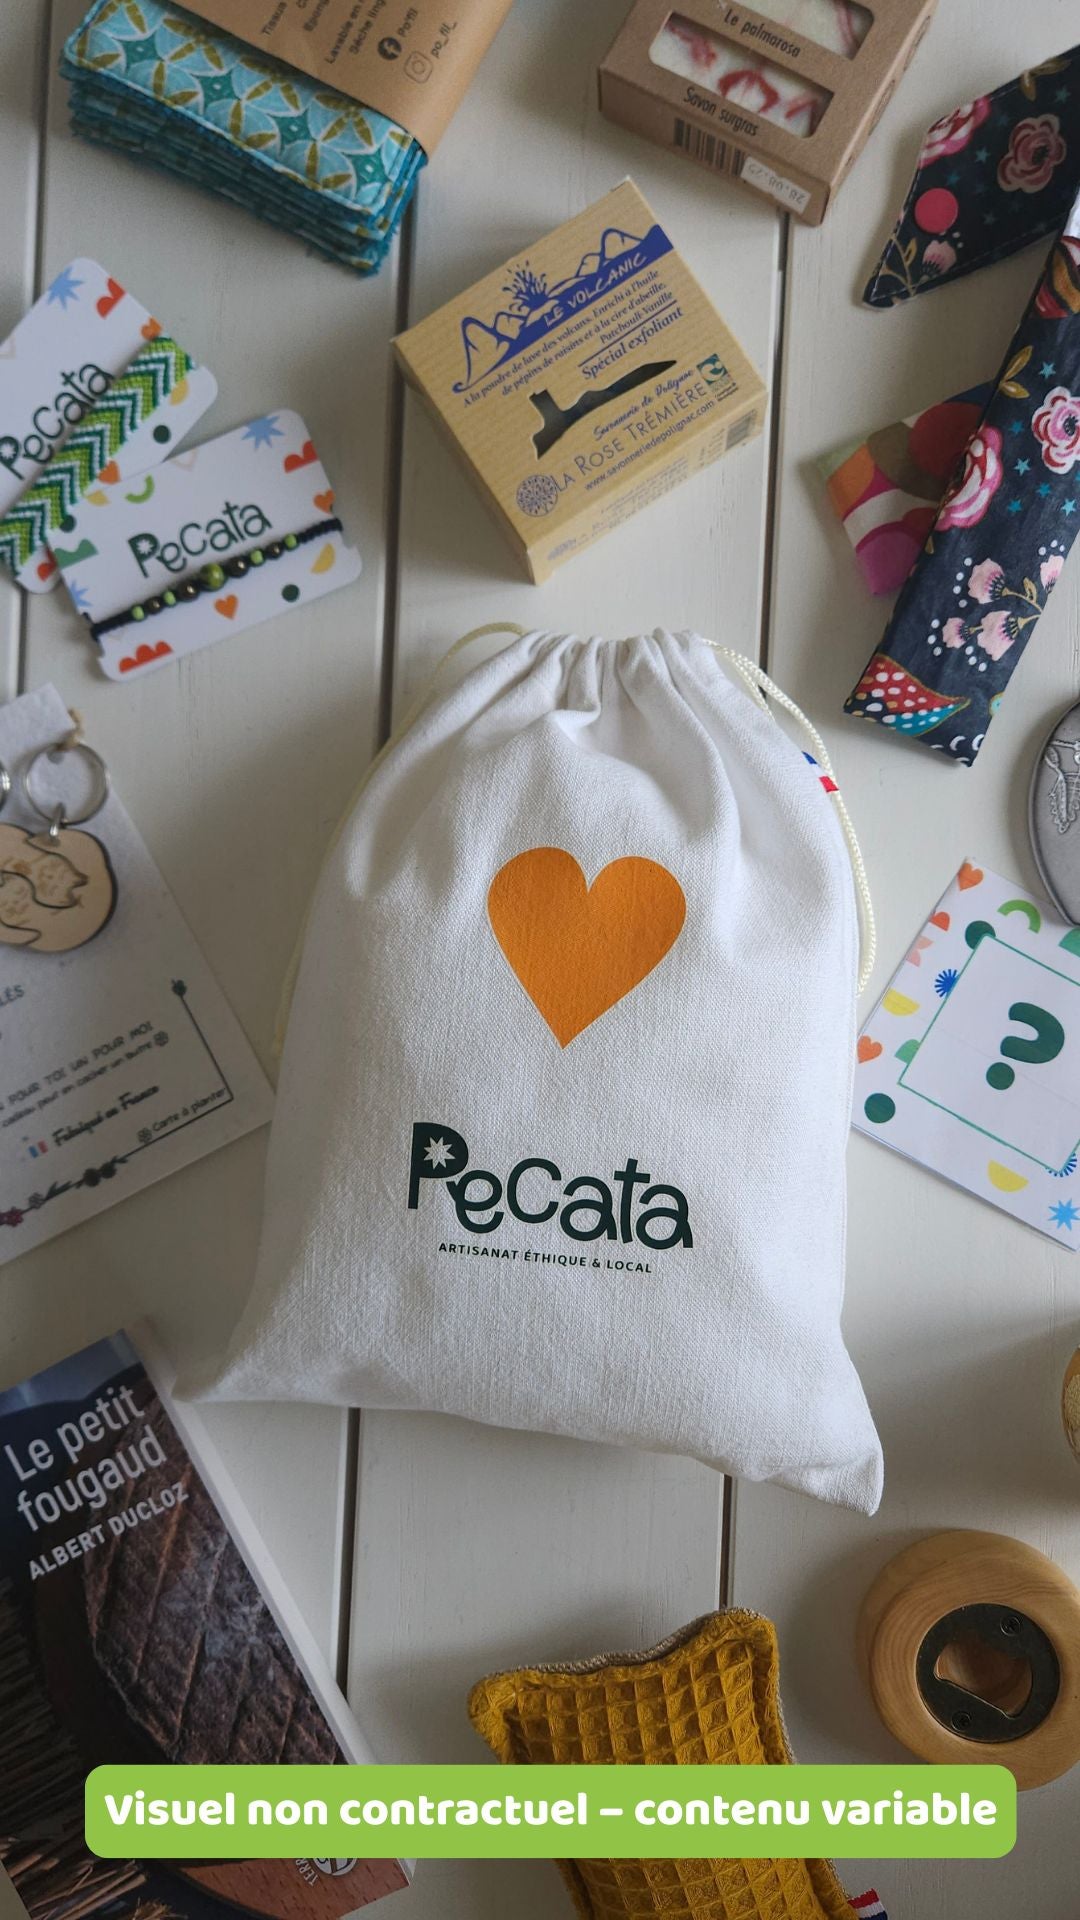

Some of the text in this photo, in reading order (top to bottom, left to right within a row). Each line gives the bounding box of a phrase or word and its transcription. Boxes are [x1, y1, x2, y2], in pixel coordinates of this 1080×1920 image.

[723, 9, 801, 58] Le palmarosa
[683, 86, 758, 137] Savon surgras
[544, 252, 647, 328] LE VOLCANIC
[481, 370, 512, 398] poudre
[512, 362, 522, 373] de
[522, 350, 541, 365] lave
[542, 341, 557, 353] des
[593, 293, 624, 318] Enrichi
[631, 270, 658, 291] l'huile
[502, 384, 512, 396] de
[513, 366, 543, 391] pépins
[543, 358, 553, 368] de
[554, 336, 583, 358] raisins
[584, 330, 593, 339] et
[601, 317, 610, 326] la
[611, 306, 628, 322] cire
[582, 307, 683, 379] Spécial exfoliant
[641, 395, 653, 407] de
[655, 369, 695, 397] Polignac
[553, 469, 575, 492] LA
[584, 399, 715, 490] www.savonneriedepolignac.com
[127, 501, 273, 578] Pecata
[7, 1082, 40, 1105] POUR
[43, 1067, 66, 1085] TOI
[92, 1036, 124, 1060] POUR
[129, 1021, 154, 1040] MOI
[118, 1086, 159, 1111] France
[152, 1113, 179, 1131] Carte
[191, 1087, 225, 1113] planter
[408, 1122, 693, 1250] Pecata
[438, 1242, 652, 1274] ARTISANAT ÉTHIQUE & LOCAL
[4, 1385, 145, 1482] Le petit
[17, 1424, 167, 1532] fougaud
[29, 1482, 189, 1581] ALBERT DUCLOZ
